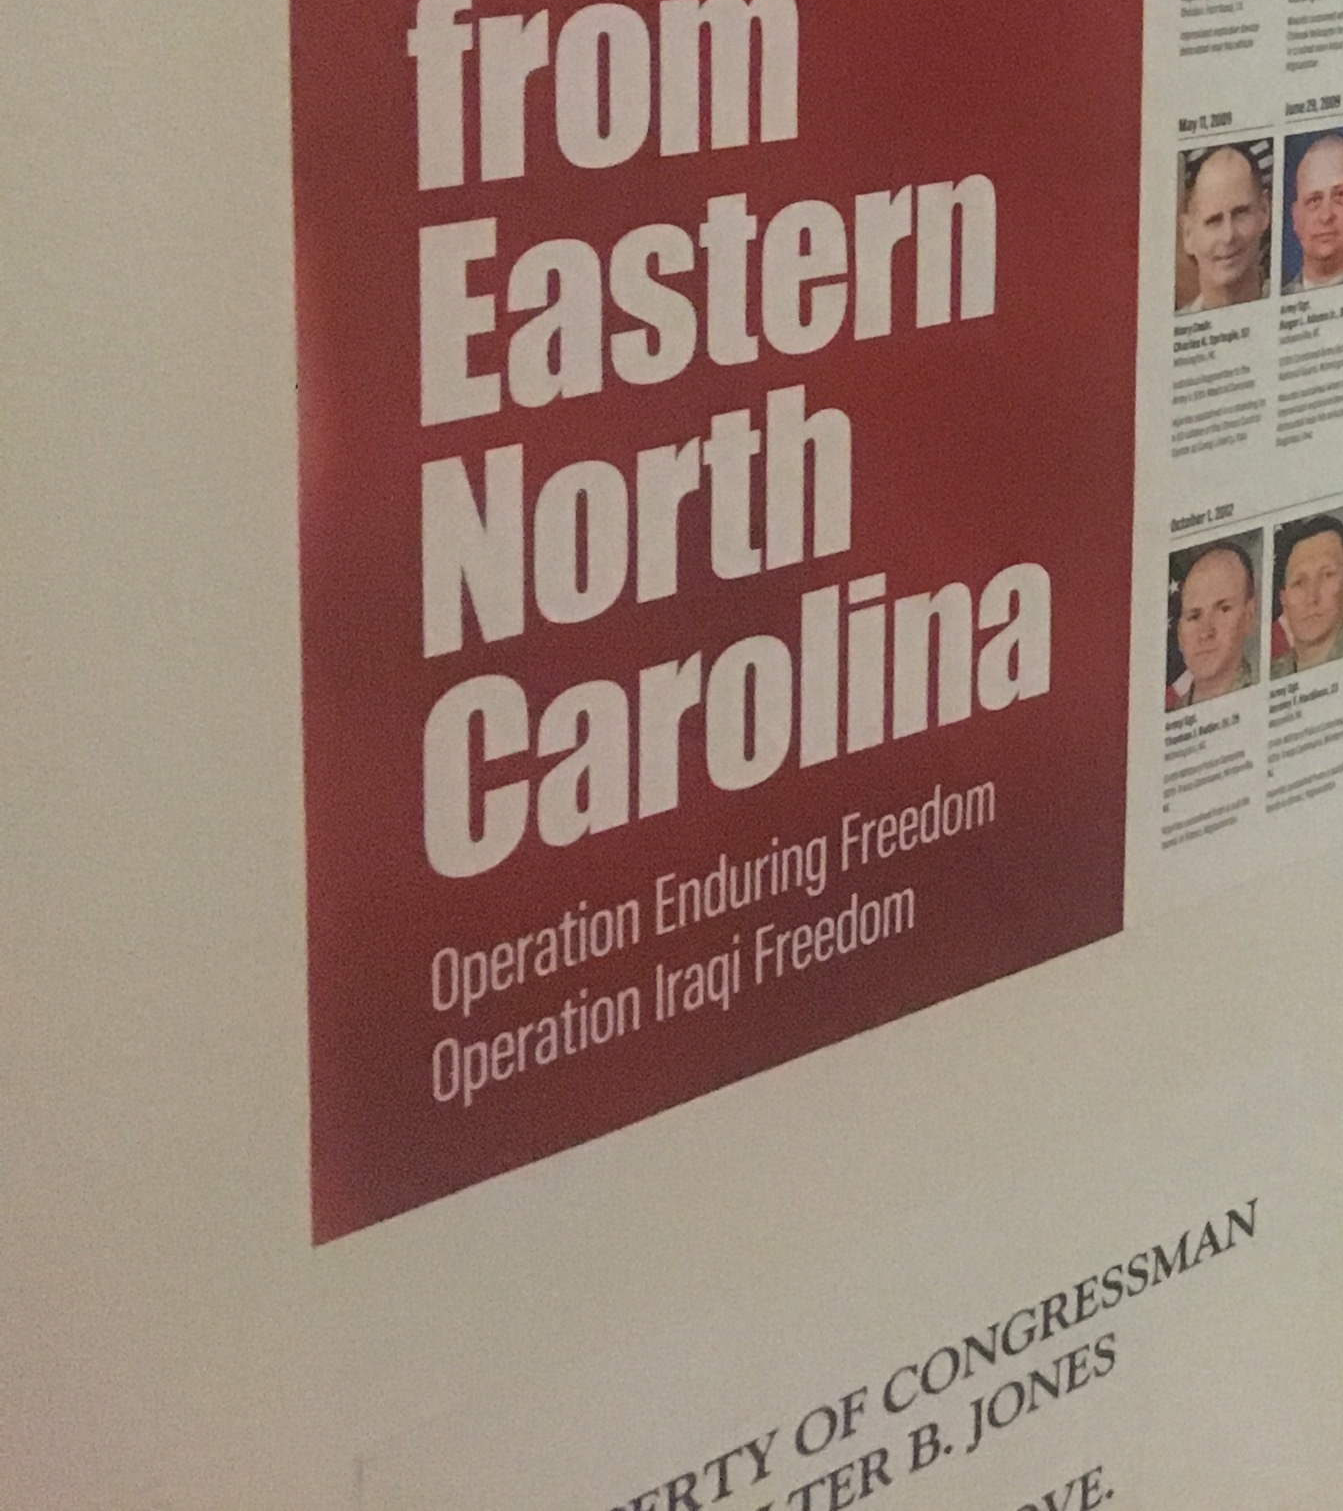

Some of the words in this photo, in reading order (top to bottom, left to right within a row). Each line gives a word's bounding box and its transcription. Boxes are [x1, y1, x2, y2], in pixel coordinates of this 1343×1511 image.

[1179, 118, 1197, 134] May
[1211, 111, 1232, 128] 2009
[1285, 102, 1305, 117] June
[419, 174, 997, 427] Eastern
[421, 384, 853, 659] North
[1171, 512, 1206, 533] October
[423, 562, 1052, 879] Carolina
[431, 897, 640, 1017] Operation
[656, 837, 828, 936] Enduring
[841, 780, 996, 872] Freedom
[431, 987, 641, 1107] Operation
[656, 935, 741, 1022] Iraqi
[755, 887, 915, 985] Freedom
[794, 1386, 868, 1457] OF
[882, 1198, 1259, 1416] CONGRESSMAN
[907, 1423, 954, 1474] B.
[965, 1332, 1117, 1453] JONES
